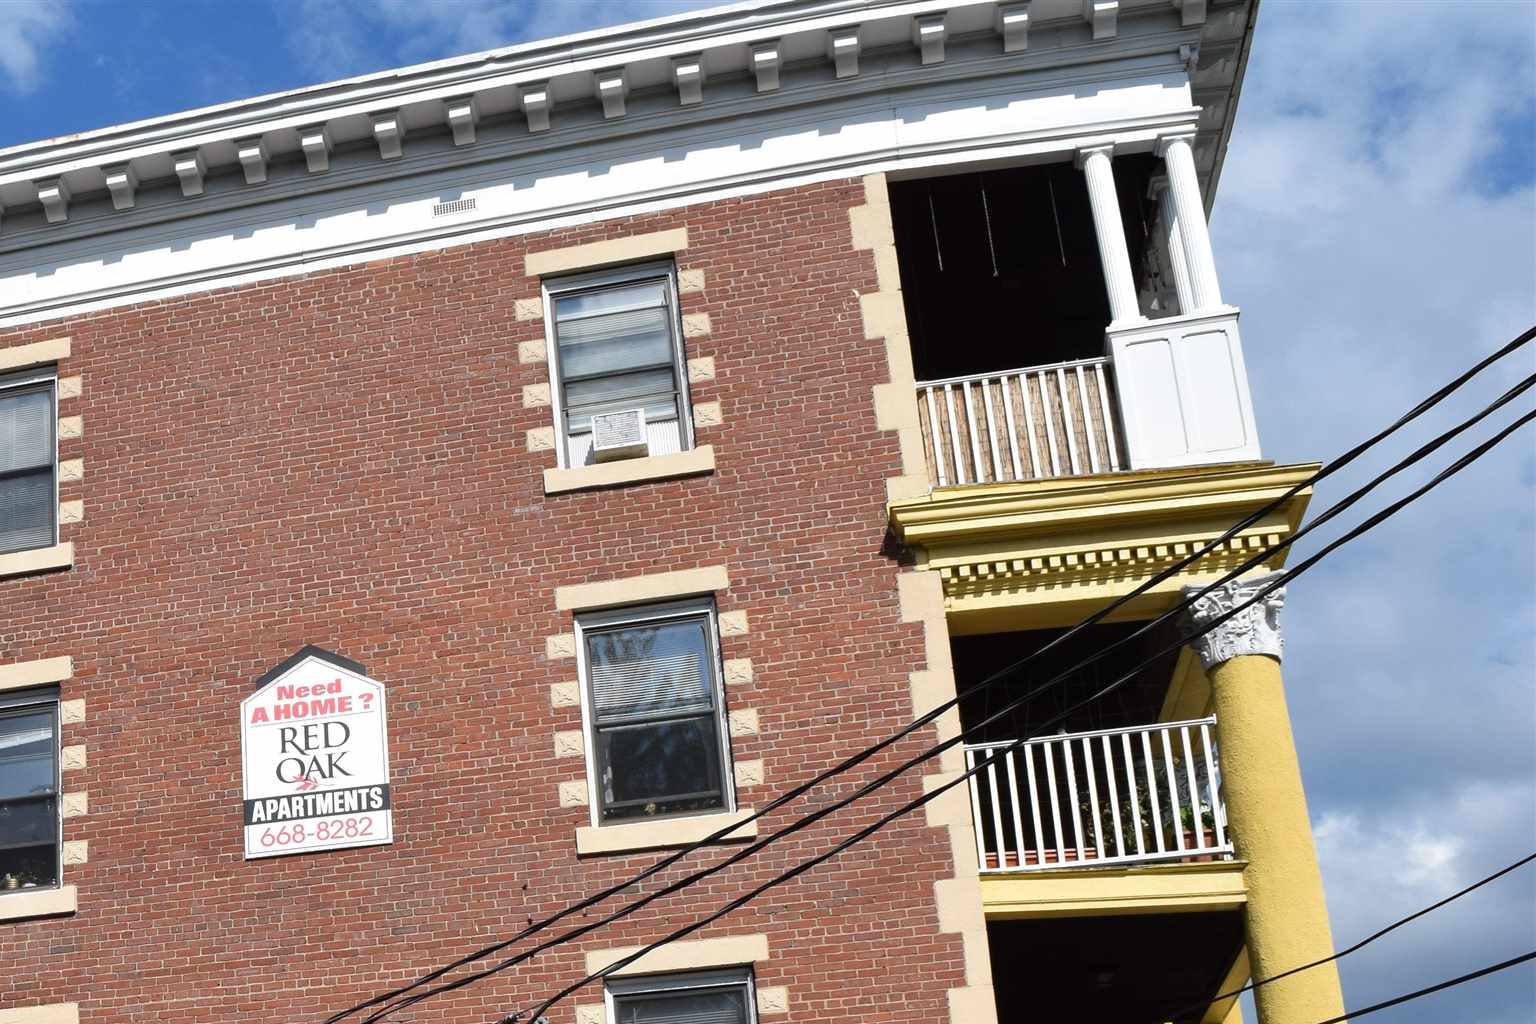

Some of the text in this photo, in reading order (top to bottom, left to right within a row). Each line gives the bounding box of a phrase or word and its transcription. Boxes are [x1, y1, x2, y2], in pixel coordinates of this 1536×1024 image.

[277, 679, 342, 700] Need
[251, 707, 269, 724] A
[274, 696, 352, 720] HOME
[279, 721, 350, 756] RED
[276, 751, 354, 784] OAK
[252, 787, 383, 823] APARTMENTS
[260, 816, 373, 847] 668-8282
